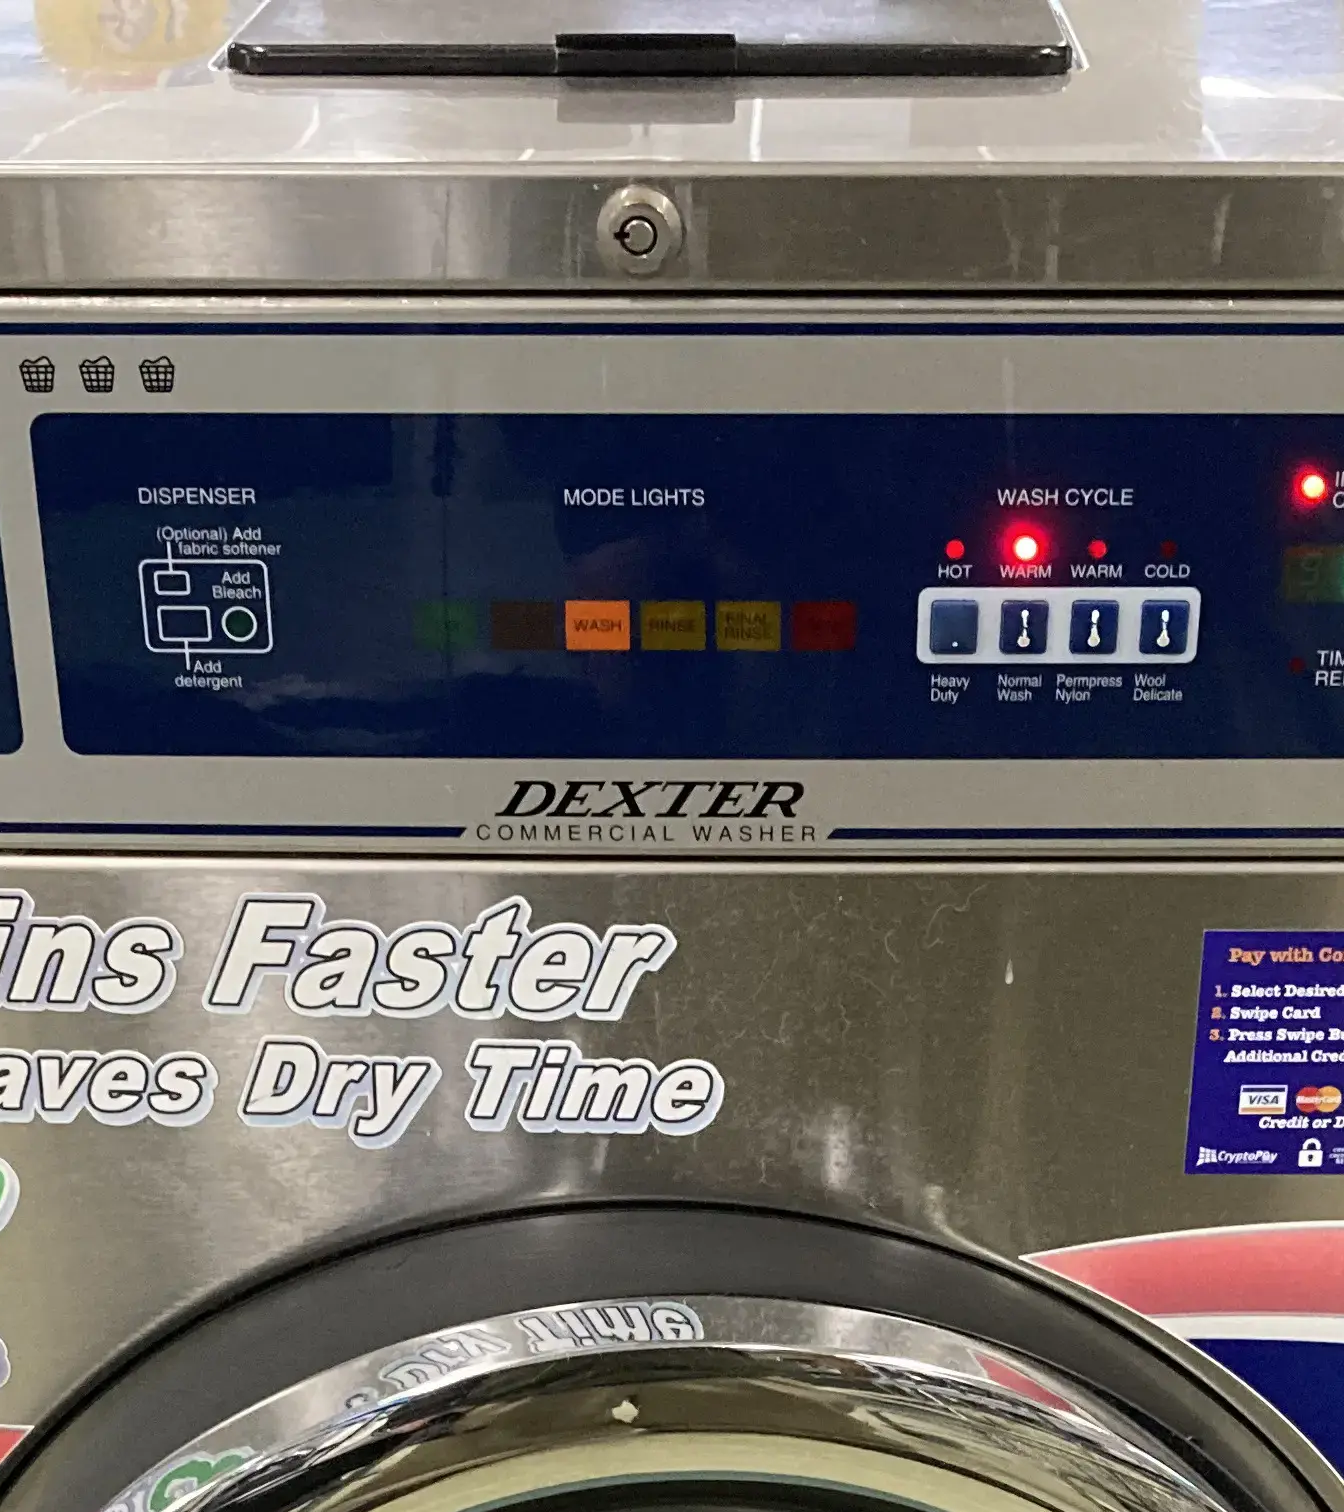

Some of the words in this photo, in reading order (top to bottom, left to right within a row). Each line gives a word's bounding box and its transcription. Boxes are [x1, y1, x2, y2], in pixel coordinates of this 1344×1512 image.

[138, 487, 256, 505] DISPENSER
[563, 488, 625, 507] MODE
[631, 488, 705, 507] LIGHTS
[998, 488, 1059, 506] WASH
[1065, 488, 1134, 506] CYCLE
[156, 526, 228, 542] (Optional)
[233, 528, 262, 541] Add
[178, 542, 218, 556] fabric
[223, 542, 282, 556] softener
[222, 571, 250, 584] Add
[937, 564, 973, 579] HOT
[999, 564, 1052, 579] WARM
[1070, 564, 1123, 579] WARM
[1144, 564, 1190, 579] COLD
[212, 585, 262, 599] Bleach
[573, 619, 623, 633] WASH
[194, 660, 222, 673] Add
[175, 674, 242, 690] detergent
[931, 674, 970, 690] Heavy
[998, 674, 1042, 687] Normal
[1056, 674, 1122, 689] Permpress
[1134, 674, 1166, 686] Wool
[930, 689, 959, 703] Duty
[996, 689, 1032, 701] Wash
[1056, 689, 1090, 703] Nylon
[1133, 689, 1183, 701] Delicate
[494, 780, 805, 819] DEXTER
[476, 824, 675, 842] COMMERCIAL
[694, 825, 816, 842] WASHER
[207, 899, 667, 1020] Faster
[1228, 948, 1266, 966] Pay
[1270, 948, 1313, 962] with
[1215, 986, 1228, 996] 1.
[1231, 986, 1281, 997] Select
[1211, 1008, 1226, 1019] 2.
[1230, 1007, 1278, 1021] Swipe
[1282, 1006, 1321, 1018] Card
[1210, 1030, 1224, 1040] 3.
[1228, 1029, 1272, 1041] Press
[1276, 1029, 1324, 1043] Swipe
[1224, 1050, 1308, 1062] Additional
[243, 1040, 432, 1138] Dry
[468, 1041, 718, 1126] Time
[1248, 1095, 1279, 1105] VISA
[1258, 1116, 1308, 1128] Credit
[1312, 1118, 1332, 1128] or
